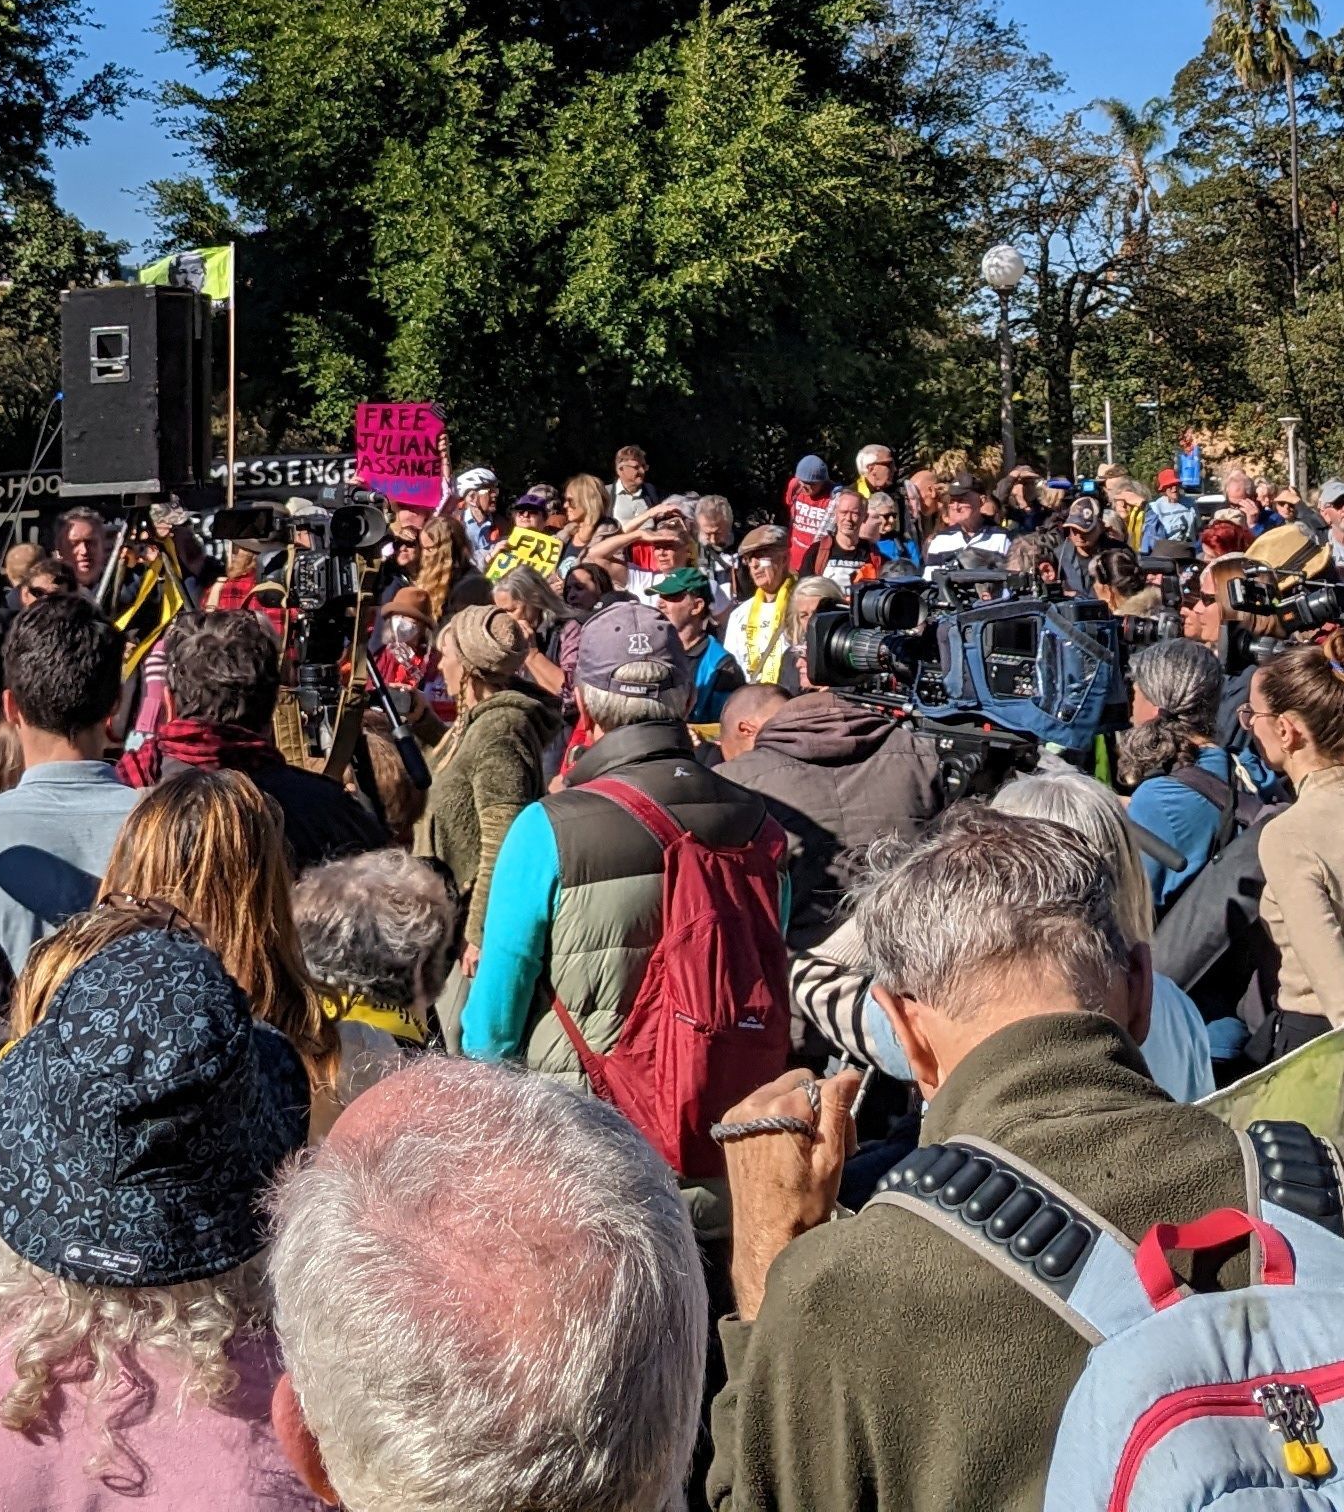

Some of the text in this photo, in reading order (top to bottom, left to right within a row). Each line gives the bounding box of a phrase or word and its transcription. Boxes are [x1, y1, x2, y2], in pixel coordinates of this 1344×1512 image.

[365, 407, 427, 431] FREE
[357, 432, 440, 457] JULIAN
[359, 456, 441, 478] ASSANGE
[796, 500, 827, 520] FREE
